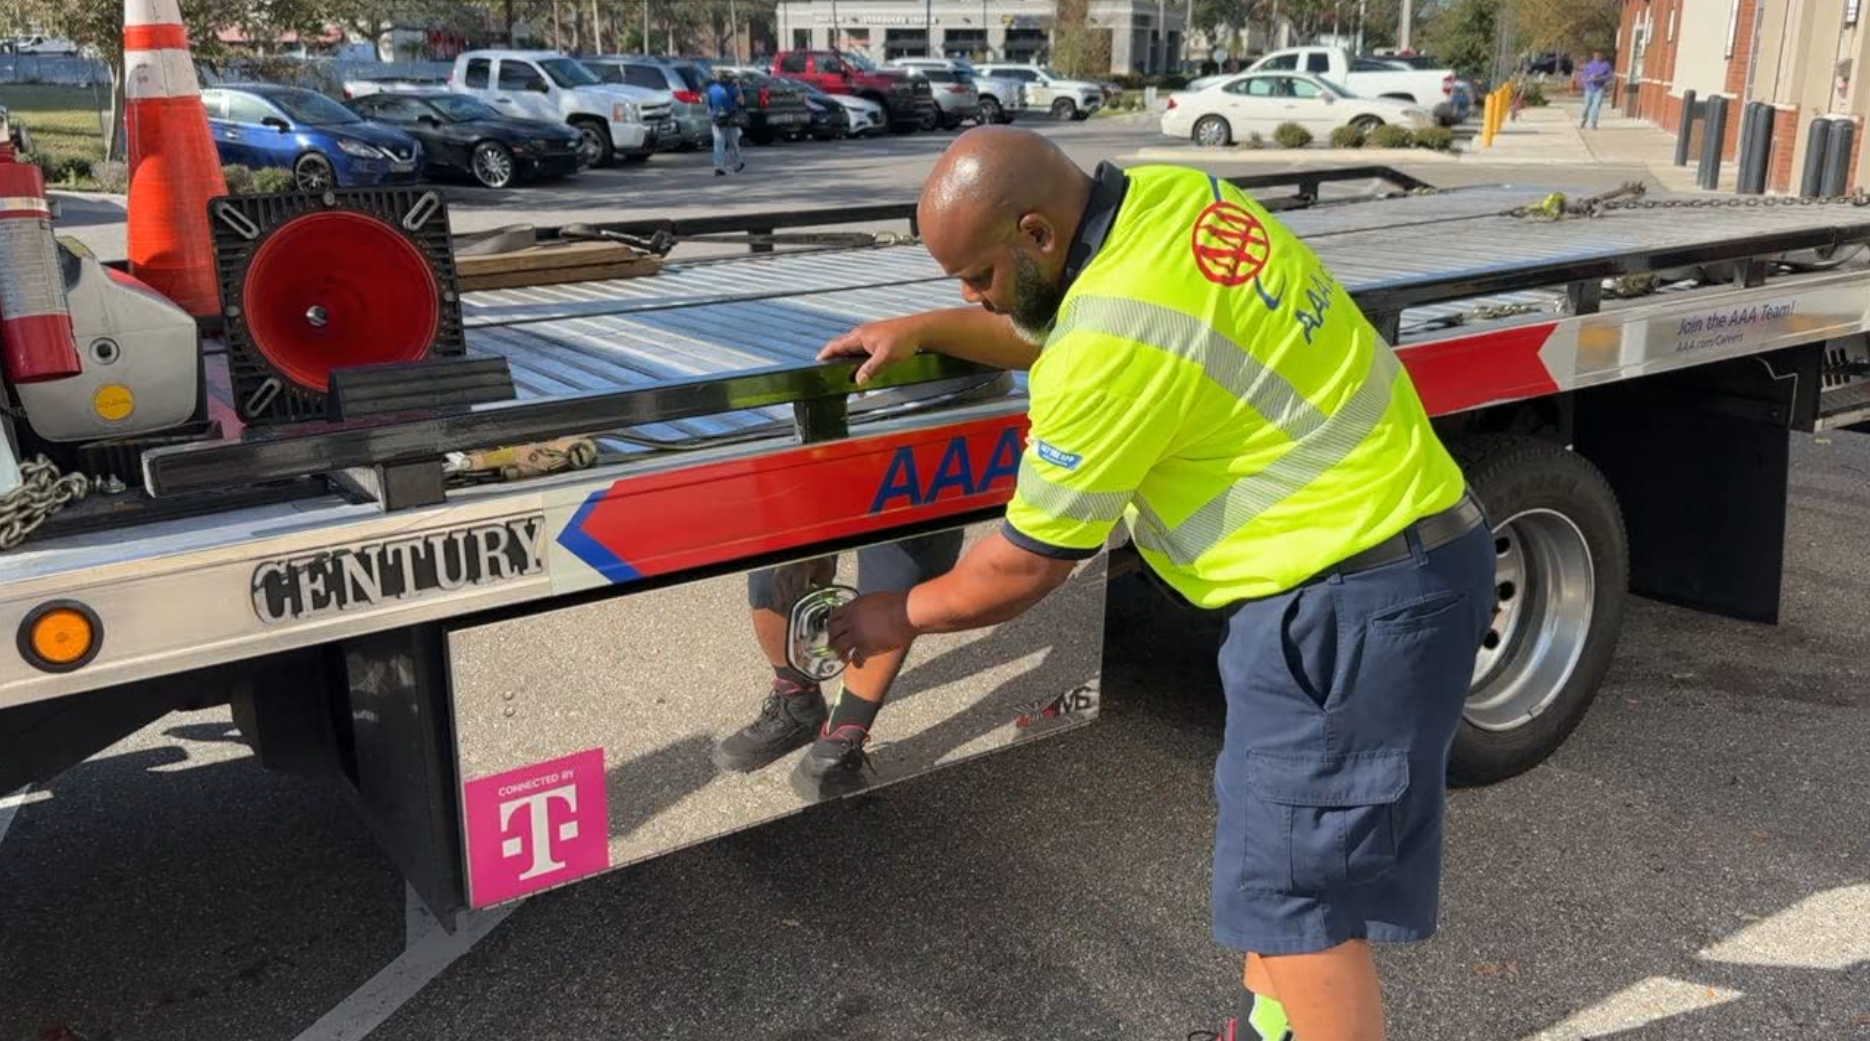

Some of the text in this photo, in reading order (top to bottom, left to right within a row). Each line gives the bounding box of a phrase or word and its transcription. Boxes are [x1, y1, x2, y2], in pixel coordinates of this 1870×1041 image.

[1677, 300, 1797, 336] Join the AAA Team!
[869, 427, 1021, 516] AAA
[251, 515, 546, 625] CENTURY
[498, 769, 574, 796] CONNECTED BY
